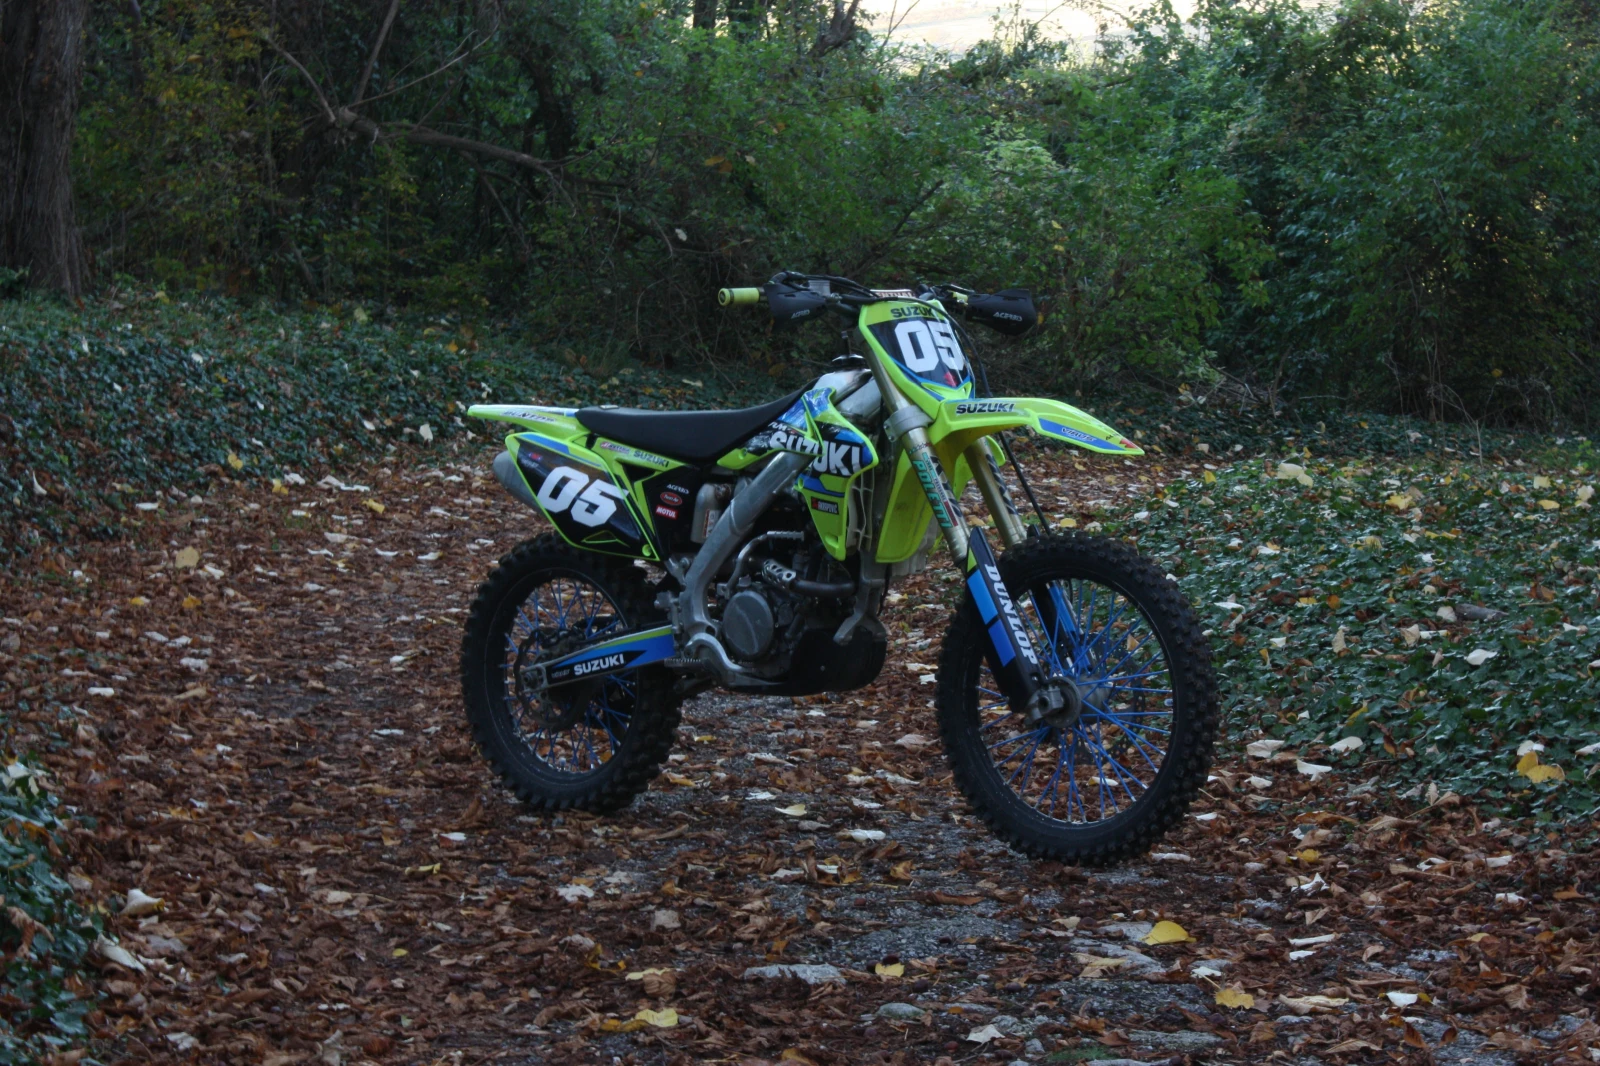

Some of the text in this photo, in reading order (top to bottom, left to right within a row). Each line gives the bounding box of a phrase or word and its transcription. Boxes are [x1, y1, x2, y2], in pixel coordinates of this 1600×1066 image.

[890, 306, 936, 318] SUZUK
[894, 319, 965, 373] 05
[956, 403, 1015, 414] SUZUKI
[633, 450, 670, 468] SUZUKI
[537, 465, 630, 528] 05
[912, 460, 953, 528] POLETTI
[655, 506, 677, 519] MOTUL
[984, 563, 1039, 665] DUNLOP
[573, 653, 625, 676] SUZUKI
